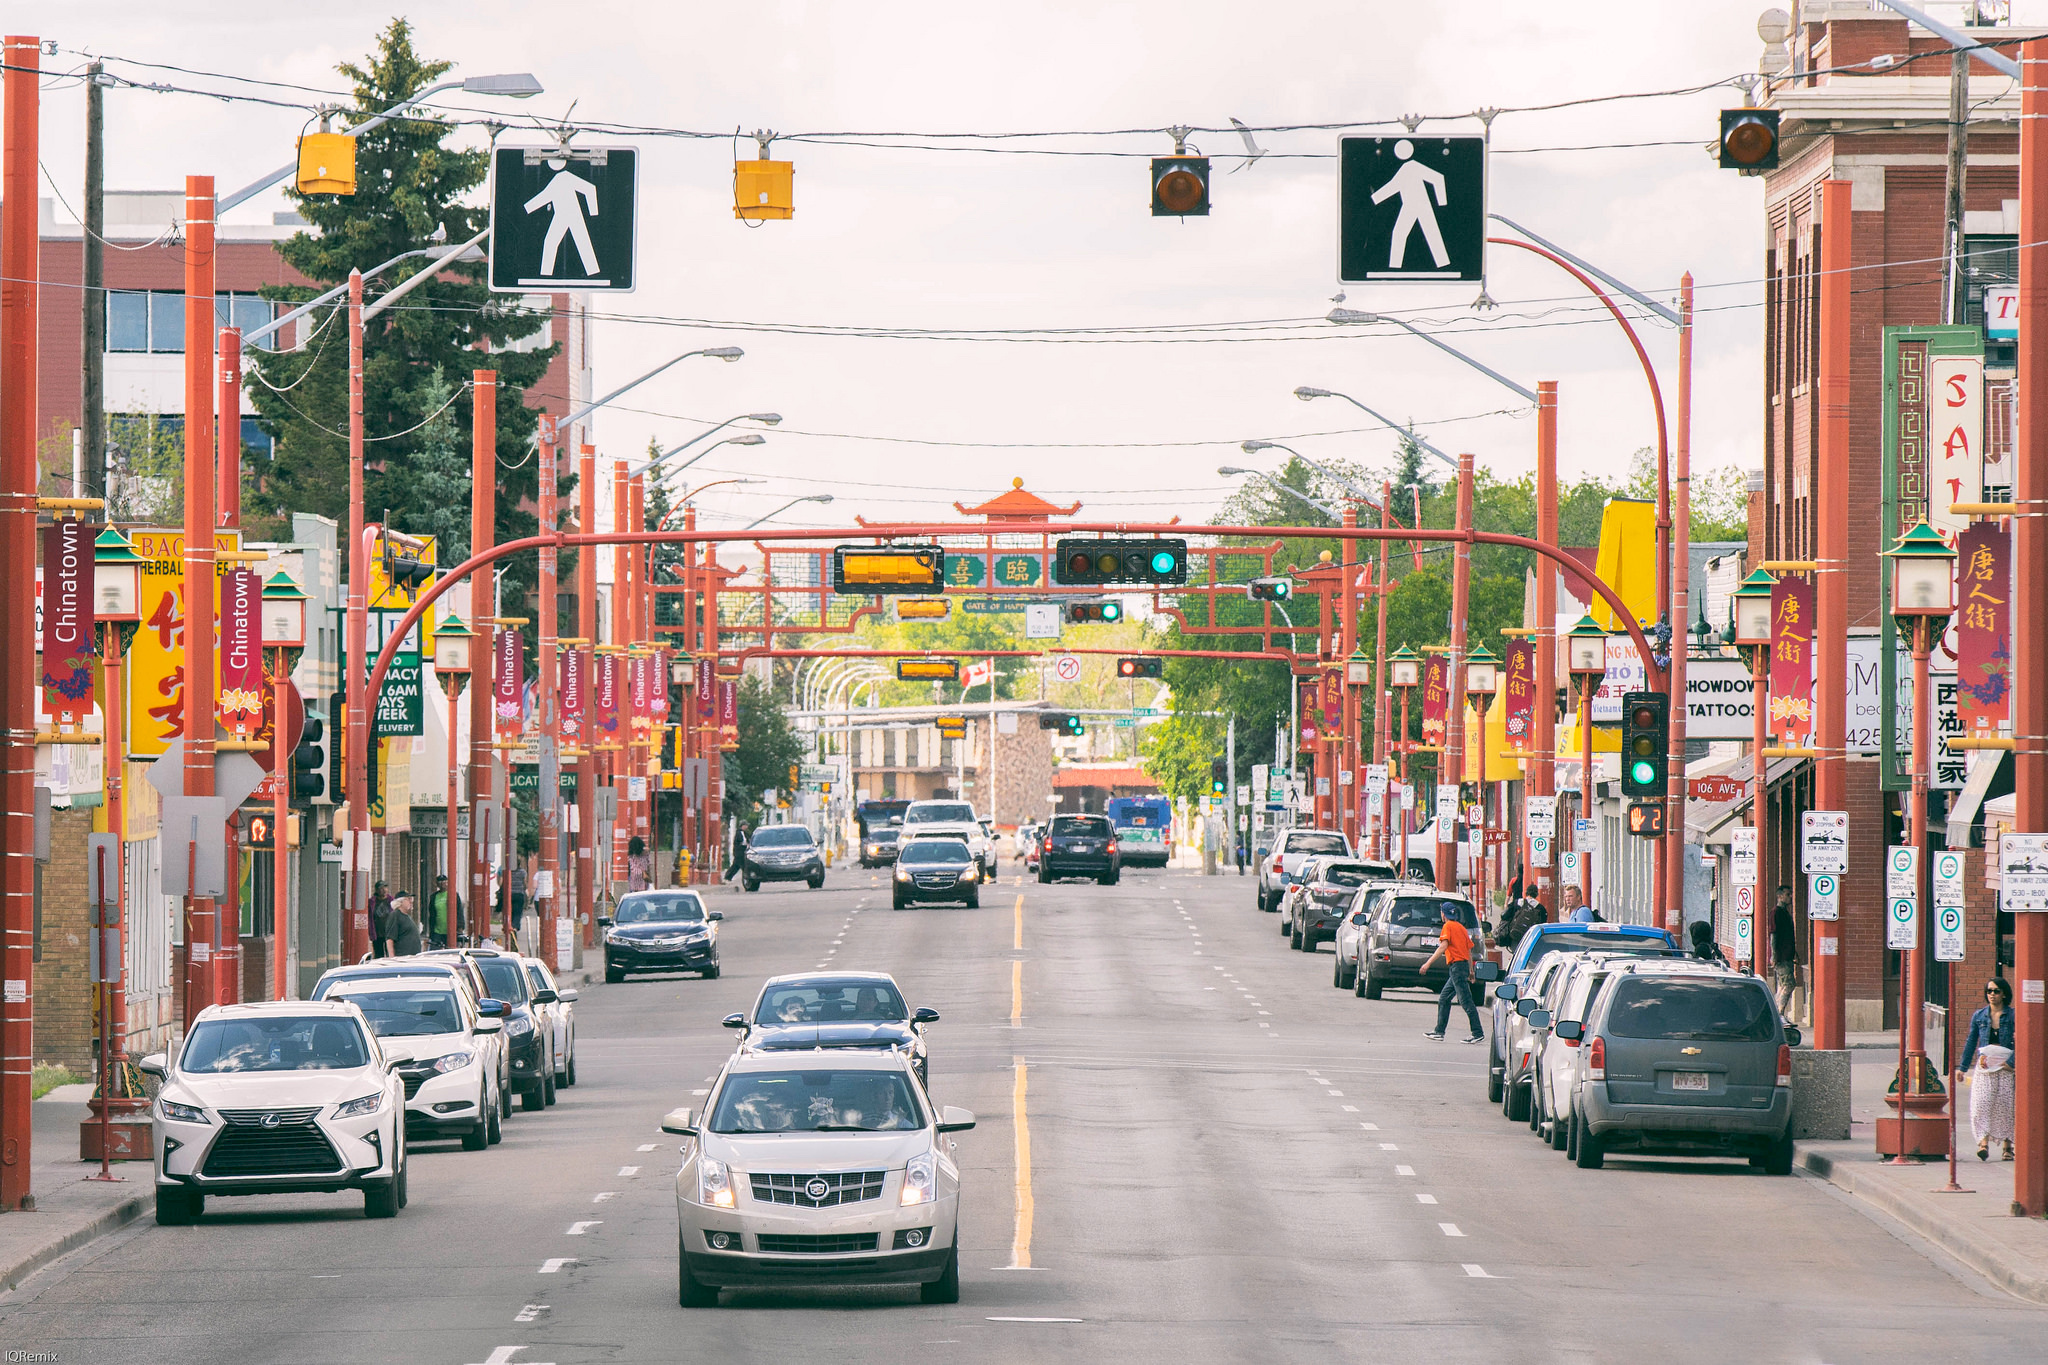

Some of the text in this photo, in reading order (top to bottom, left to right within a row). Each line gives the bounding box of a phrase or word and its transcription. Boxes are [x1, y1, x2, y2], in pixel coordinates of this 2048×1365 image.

[55, 522, 77, 642] Chinatown
[1964, 544, 2005, 632] 唐人街
[230, 570, 248, 669] Chinatown
[967, 602, 1024, 610] GATE OF HAPP
[1776, 593, 1808, 664] 唐人街
[502, 630, 514, 696] Chinatown
[565, 650, 577, 708] Chinatown
[602, 655, 613, 708] Chinatown
[635, 659, 645, 707] Chinatown
[653, 650, 662, 695] Chinatown
[702, 660, 710, 700] Chinatown
[1427, 664, 1444, 703] 唐人街
[1509, 650, 1530, 697] 唐人街
[378, 697, 405, 708] AYS
[387, 685, 417, 696] 6AM
[725, 681, 733, 719] Chinatown
[1593, 703, 1621, 713] Vietname
[378, 724, 414, 732] ELIVERY
[1697, 783, 1736, 794] 106 AVE
[412, 827, 438, 835] REGENT
